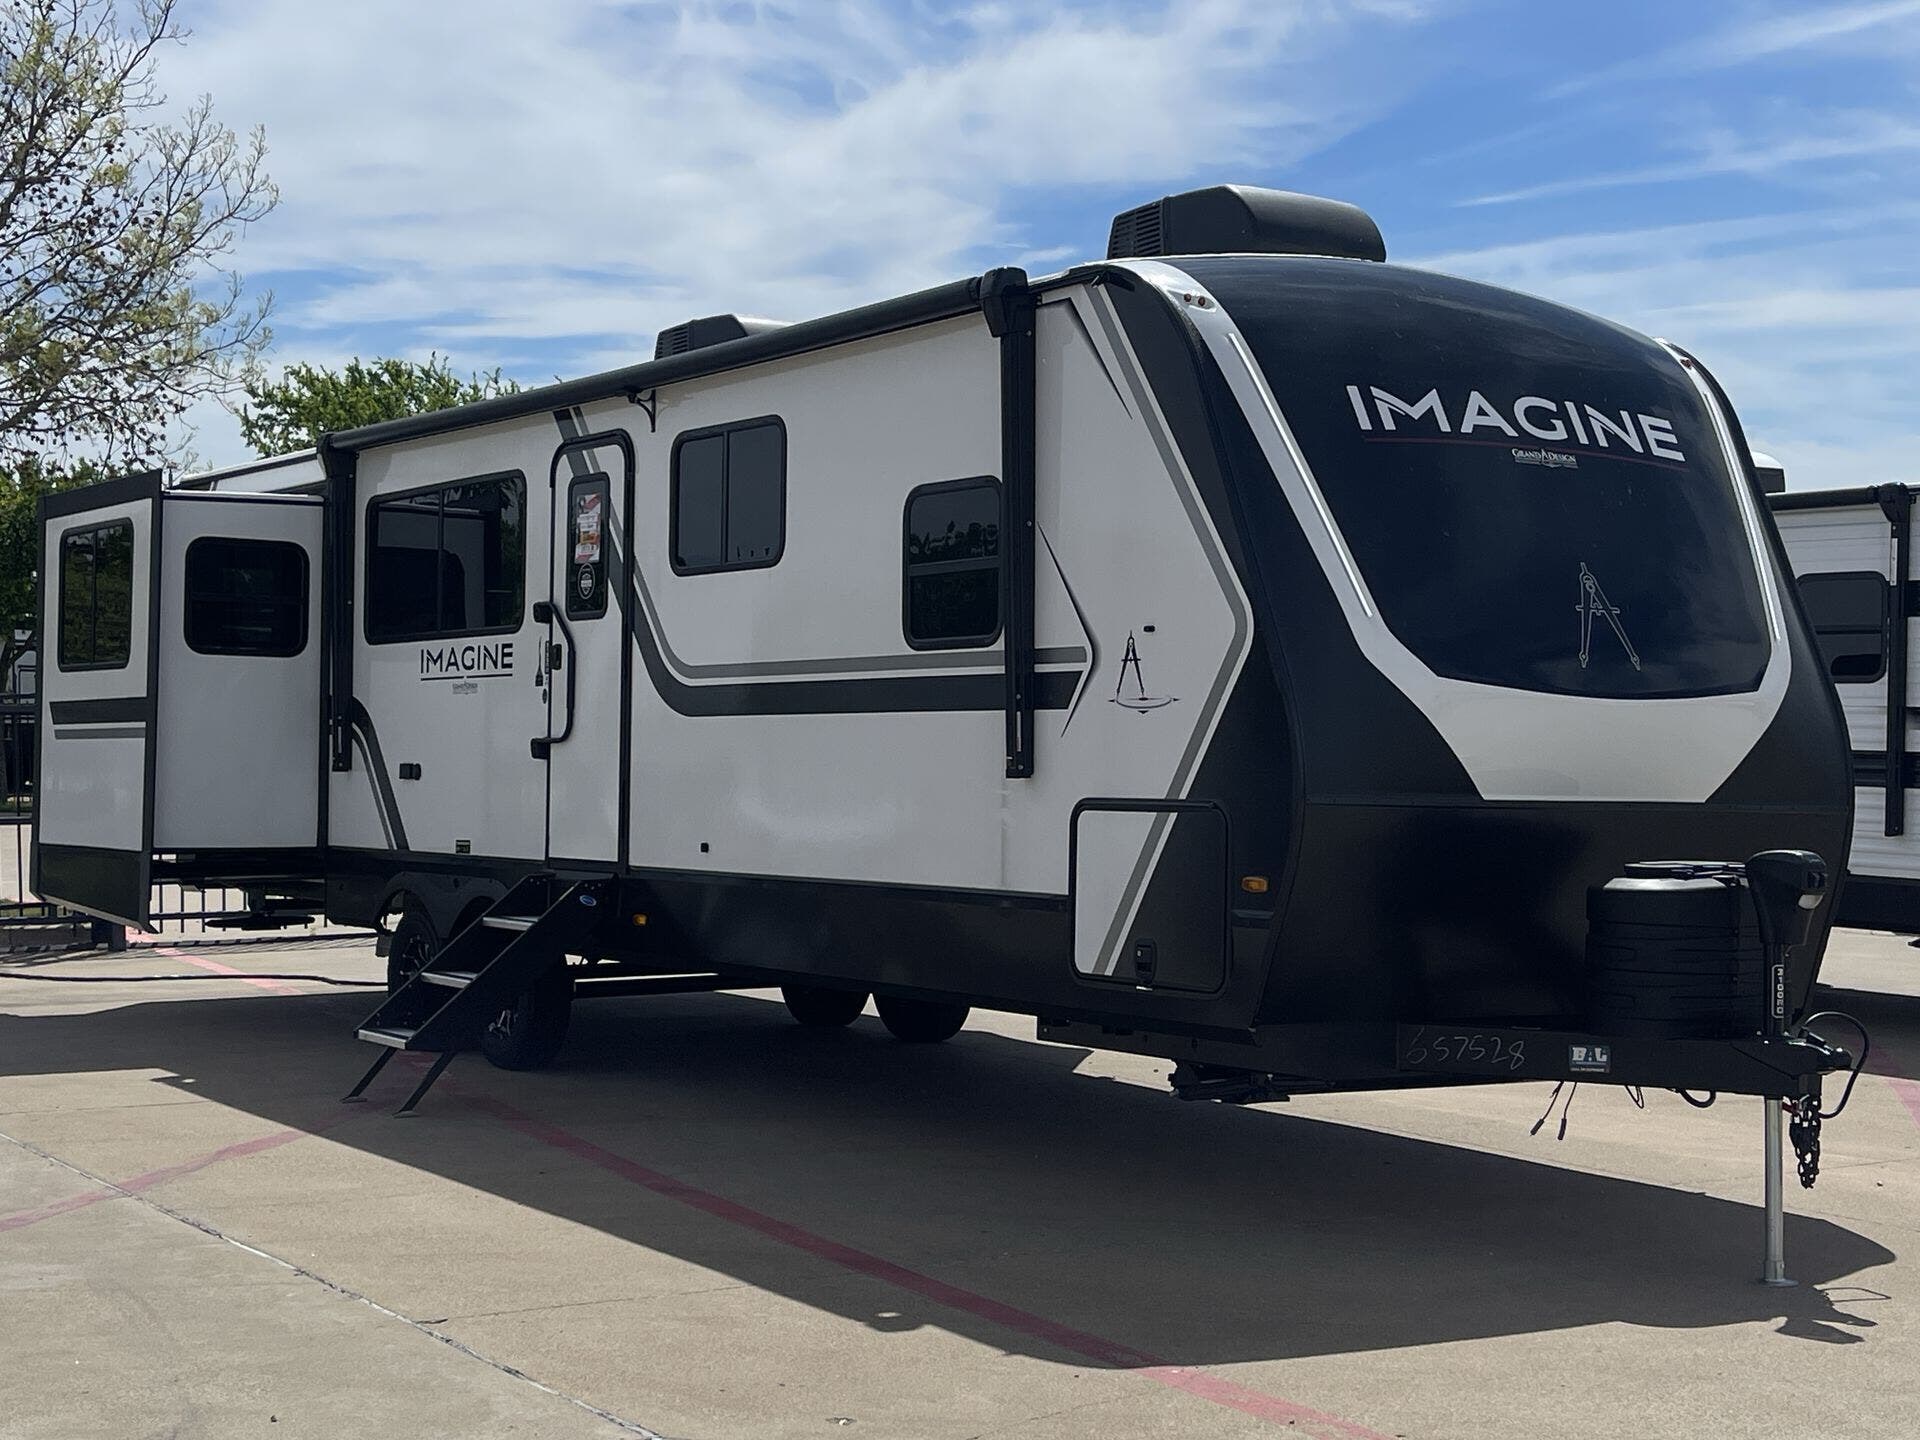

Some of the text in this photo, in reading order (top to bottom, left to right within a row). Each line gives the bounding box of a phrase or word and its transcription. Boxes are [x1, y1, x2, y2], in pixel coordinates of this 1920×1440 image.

[1346, 385, 1686, 462] IMAGINE
[420, 643, 513, 674] IMAGINE
[1406, 1026, 1525, 1070] 657528
